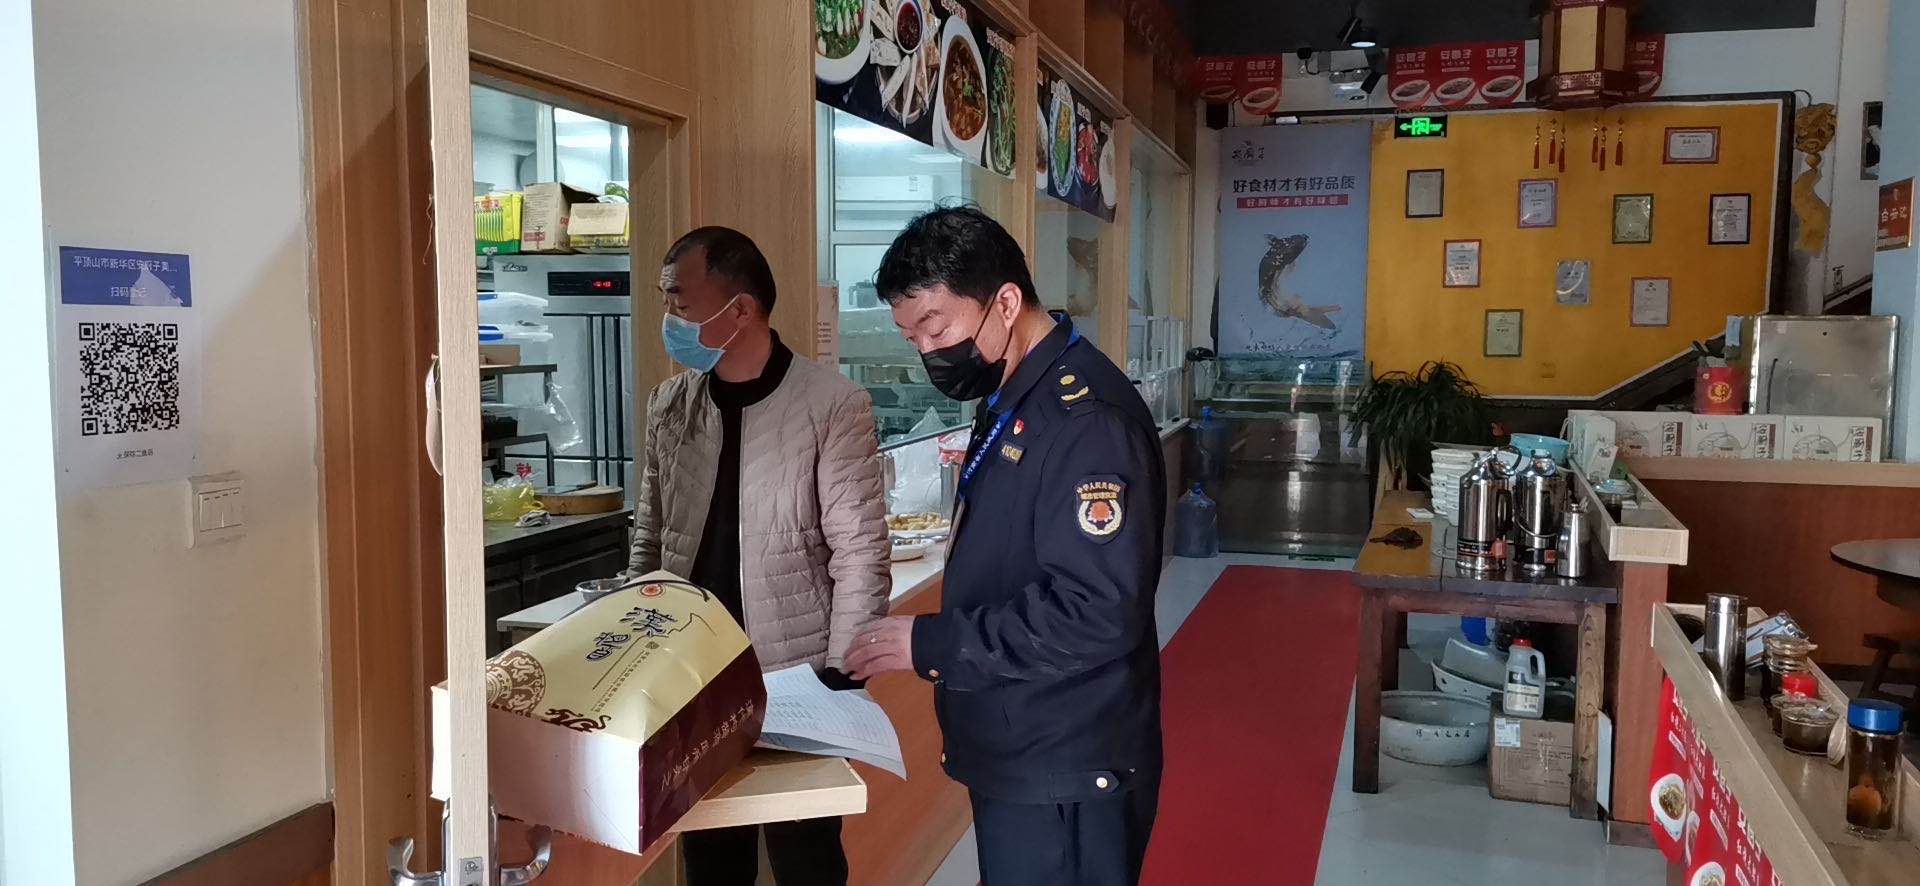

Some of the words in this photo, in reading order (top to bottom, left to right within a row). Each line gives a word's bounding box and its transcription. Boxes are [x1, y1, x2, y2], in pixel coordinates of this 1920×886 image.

[1233, 175, 1356, 193] 好食材才有好品质
